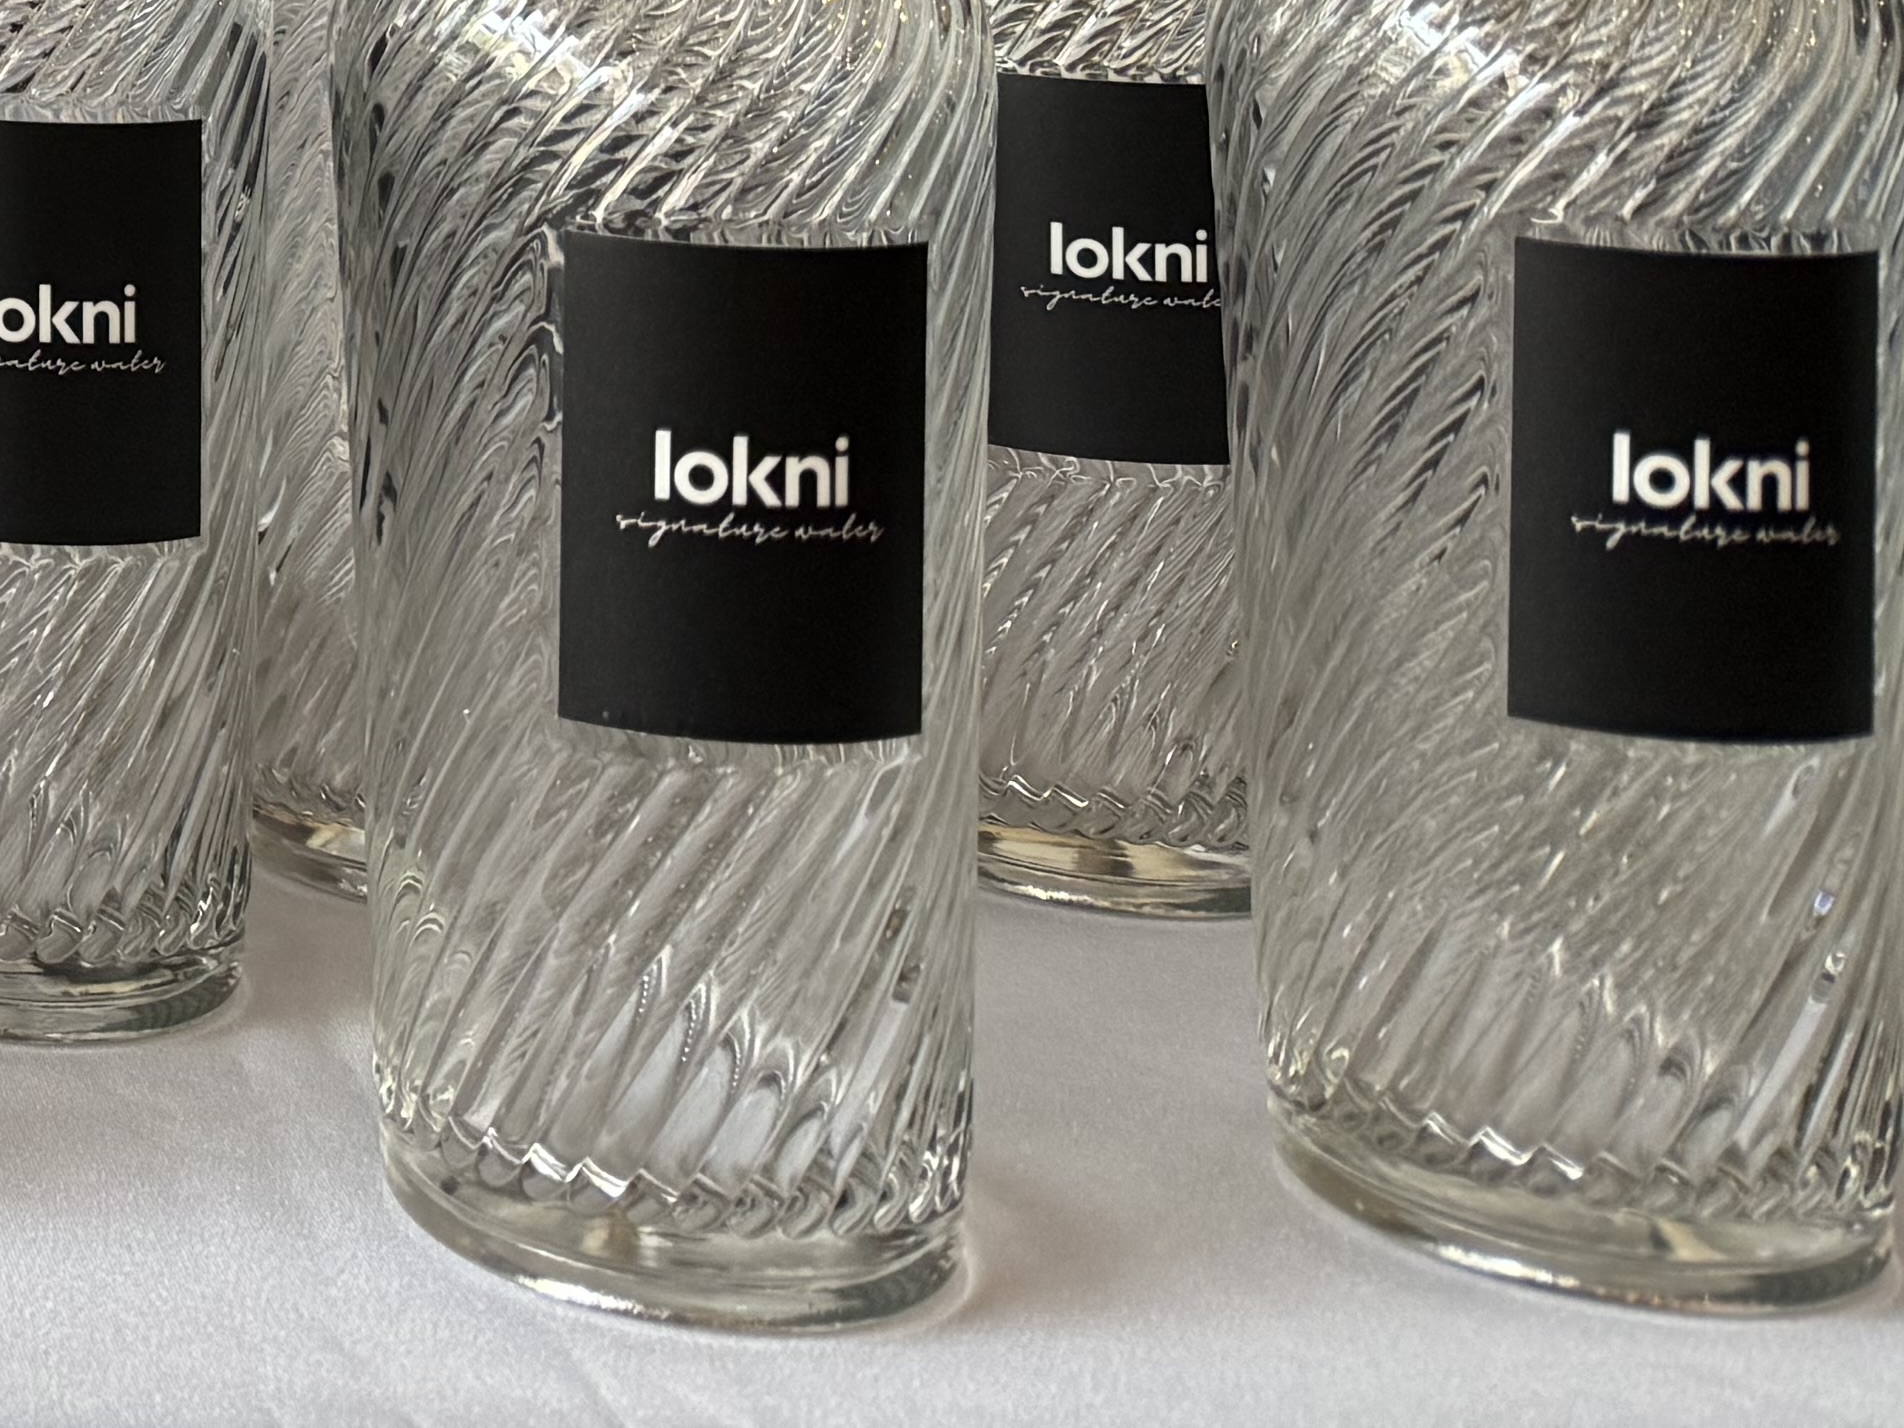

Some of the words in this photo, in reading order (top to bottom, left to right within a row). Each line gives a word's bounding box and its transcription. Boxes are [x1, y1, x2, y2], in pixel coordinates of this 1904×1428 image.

[1049, 221, 1208, 283] lokni
[91, 349, 166, 374] water
[654, 429, 849, 508] lokni
[1612, 431, 1810, 511] lokni
